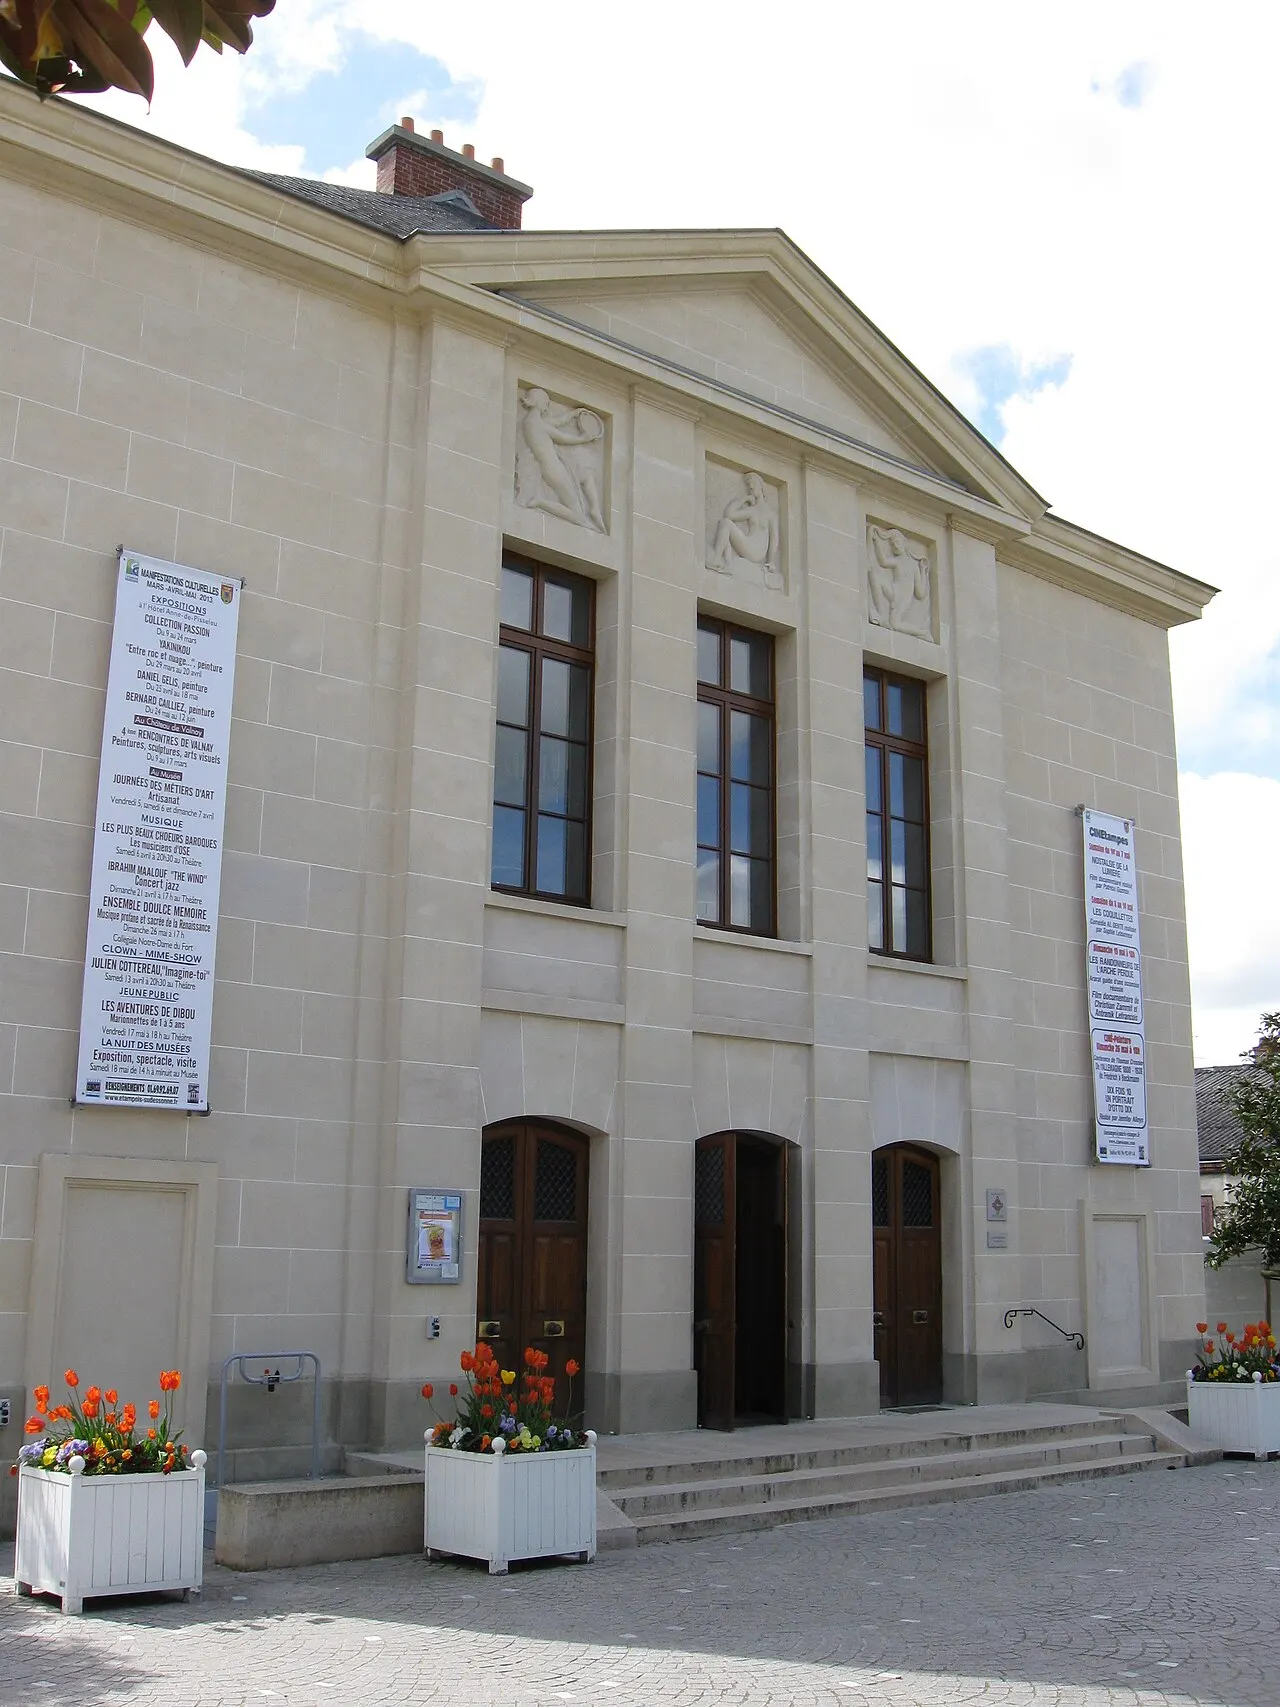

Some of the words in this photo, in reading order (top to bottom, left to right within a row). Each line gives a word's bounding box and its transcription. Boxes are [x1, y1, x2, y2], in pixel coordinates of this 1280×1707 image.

[141, 568, 184, 587] MANIFESTATIONS
[185, 580, 219, 596] CULTURELLES
[199, 594, 213, 603] 2013
[151, 595, 207, 616] EXPOSITIONS
[144, 614, 182, 631] COLLECTION
[184, 623, 210, 638] PASSION
[197, 661, 223, 673] peinture
[137, 670, 160, 682] DANIEL
[182, 681, 208, 694] peinture
[126, 691, 157, 705] BERNARD
[188, 706, 215, 718] peinture
[138, 729, 179, 746] RENCONTRES
[191, 740, 214, 752] VALNAY
[112, 736, 146, 751] Peintures,
[148, 743, 182, 758] sculptures,
[184, 750, 197, 760] arts
[199, 752, 220, 765] visuels
[160, 770, 182, 781] Musée
[113, 774, 149, 788] JOURNÉES
[150, 780, 162, 791] DES
[164, 782, 194, 797] MÉTIERS
[195, 788, 214, 800] D'ART
[110, 795, 137, 806] Vendredi
[148, 791, 180, 805] Artisanat
[141, 814, 183, 828] MUSIQUE
[102, 822, 115, 833] LES
[116, 824, 134, 835] PLUS
[135, 827, 154, 840] BEAUX
[155, 831, 184, 844] CHOEURS
[185, 835, 218, 849] BAROQUES
[116, 846, 136, 856] Samedi
[142, 841, 172, 853] musiciens
[108, 861, 136, 874] IBRAHIM
[110, 884, 136, 896] Dimanche
[135, 875, 163, 889] Concert
[164, 879, 180, 892] jazz
[103, 896, 141, 912] ENSEMBLE
[143, 902, 172, 916] DOULCE
[174, 906, 207, 920] MEMOIRE
[97, 908, 120, 922] Musique
[120, 912, 139, 924] profane
[179, 919, 211, 932] Renaissance
[1103, 909, 1133, 922] COQUILLETTES
[123, 923, 149, 935] Dimanche
[181, 942, 194, 951] Fort
[102, 944, 137, 956] CLOWN
[145, 950, 202, 963] MIME-SHOW
[91, 957, 117, 970] JULIEN
[105, 972, 124, 982] Samedi
[119, 987, 148, 998] JEUNE
[148, 990, 180, 1000] PUBLIC
[101, 1000, 115, 1012] LES
[116, 1002, 159, 1016] AVENTURES
[173, 1007, 195, 1020] DIBOU
[110, 1013, 149, 1026] Marionnettes
[102, 1026, 126, 1036] Vendredi
[114, 1039, 136, 1048] NUIT
[137, 1041, 154, 1050] DES
[156, 1042, 191, 1053] MUSÉES
[93, 1049, 134, 1064] Exposition,
[136, 1055, 174, 1068] spectacle,
[176, 1056, 196, 1068] visite
[90, 1062, 110, 1072] Samedi
[105, 1081, 145, 1093] RENSEIGNEMENTS
